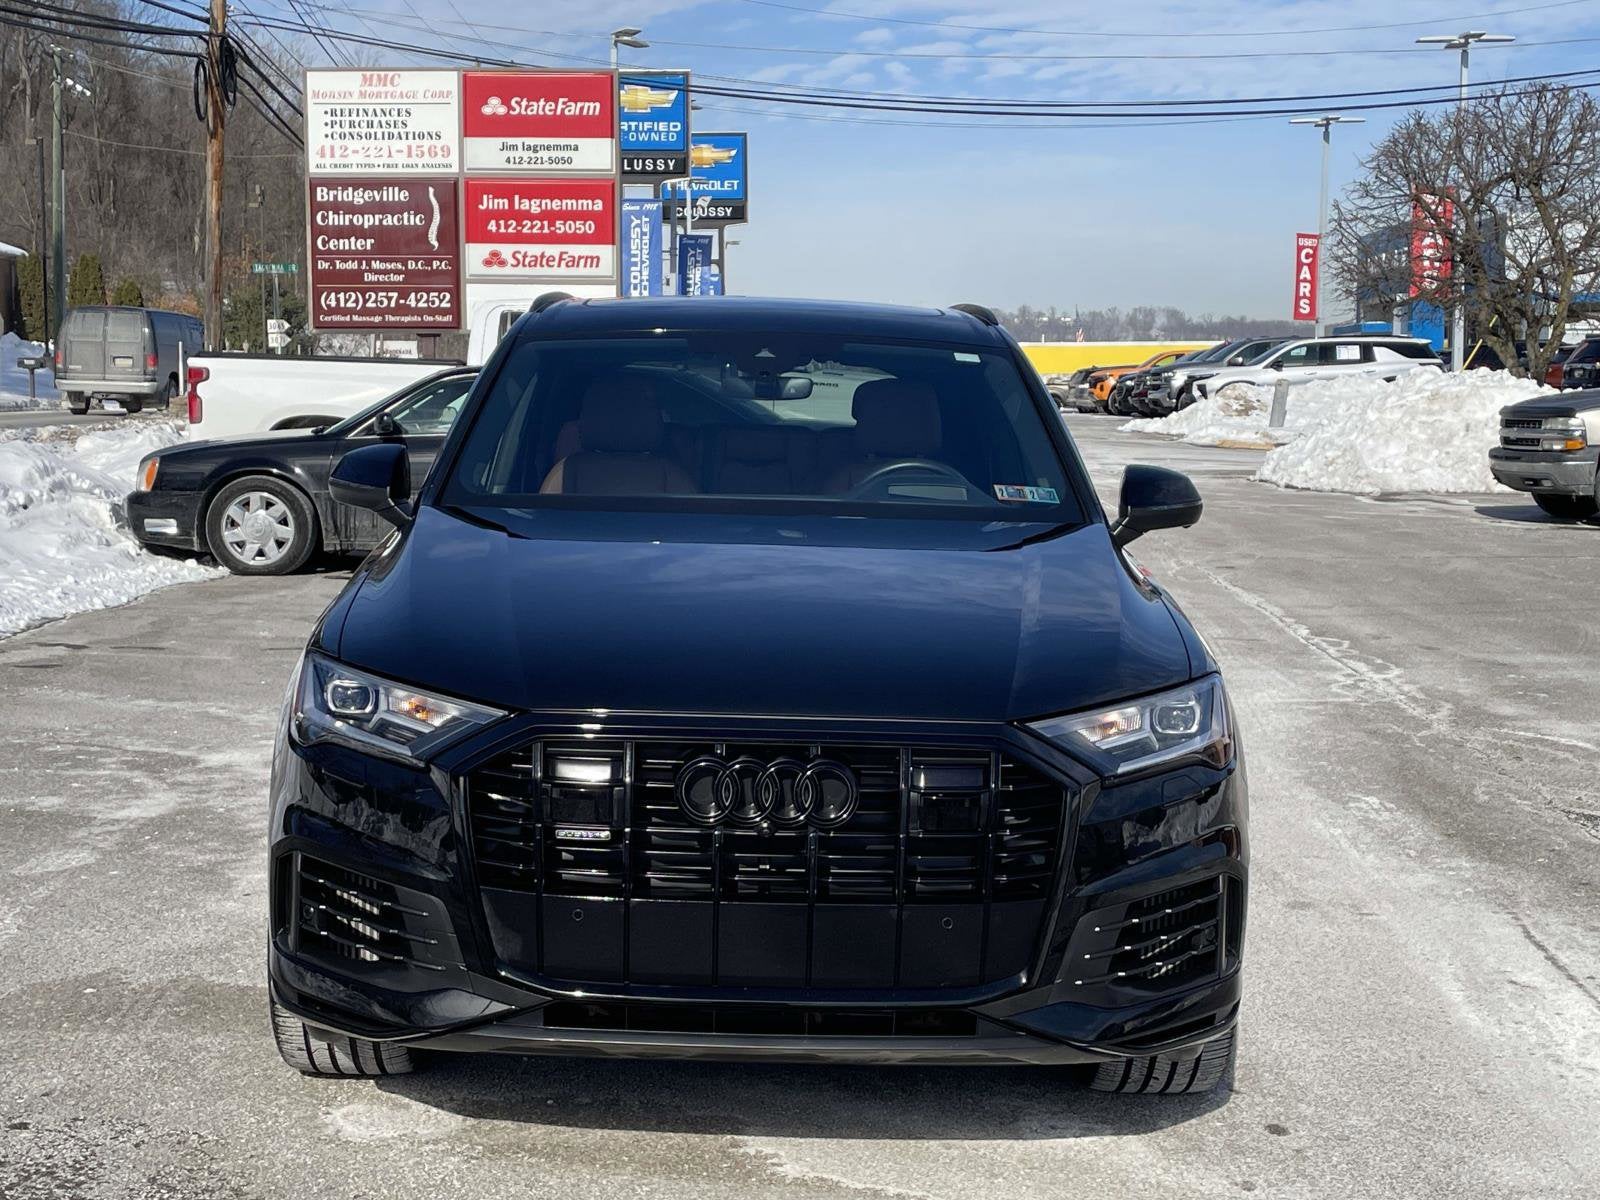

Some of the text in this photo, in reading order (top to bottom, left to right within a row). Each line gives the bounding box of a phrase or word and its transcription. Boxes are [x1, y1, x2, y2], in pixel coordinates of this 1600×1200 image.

[360, 74, 401, 87] MMC
[358, 90, 418, 100] MORTGAGE
[330, 108, 412, 118] REFINANCES
[330, 120, 408, 129] PURCHASES
[331, 131, 442, 141] CONSOLIDATIONS
[316, 144, 450, 159] 412-221-1569
[499, 142, 579, 153] Jim Iagnemma
[505, 156, 573, 165] 412-221-5050
[316, 186, 410, 204] Bridgeville
[478, 194, 603, 214] Jim Iagnemma
[316, 211, 425, 228] Chiropractic
[487, 220, 595, 234] 412-221-5050
[316, 235, 374, 250] Center
[1298, 237, 1318, 247] USED
[630, 215, 641, 296] COLUSSY
[641, 215, 650, 296] CHEVROLET
[318, 260, 452, 271] Dr. Todd J. Moses, D.C., P.C.
[364, 273, 405, 282] Director
[1299, 248, 1314, 314] CARS
[320, 314, 452, 322] Certified Massage Therapists On-Staff
